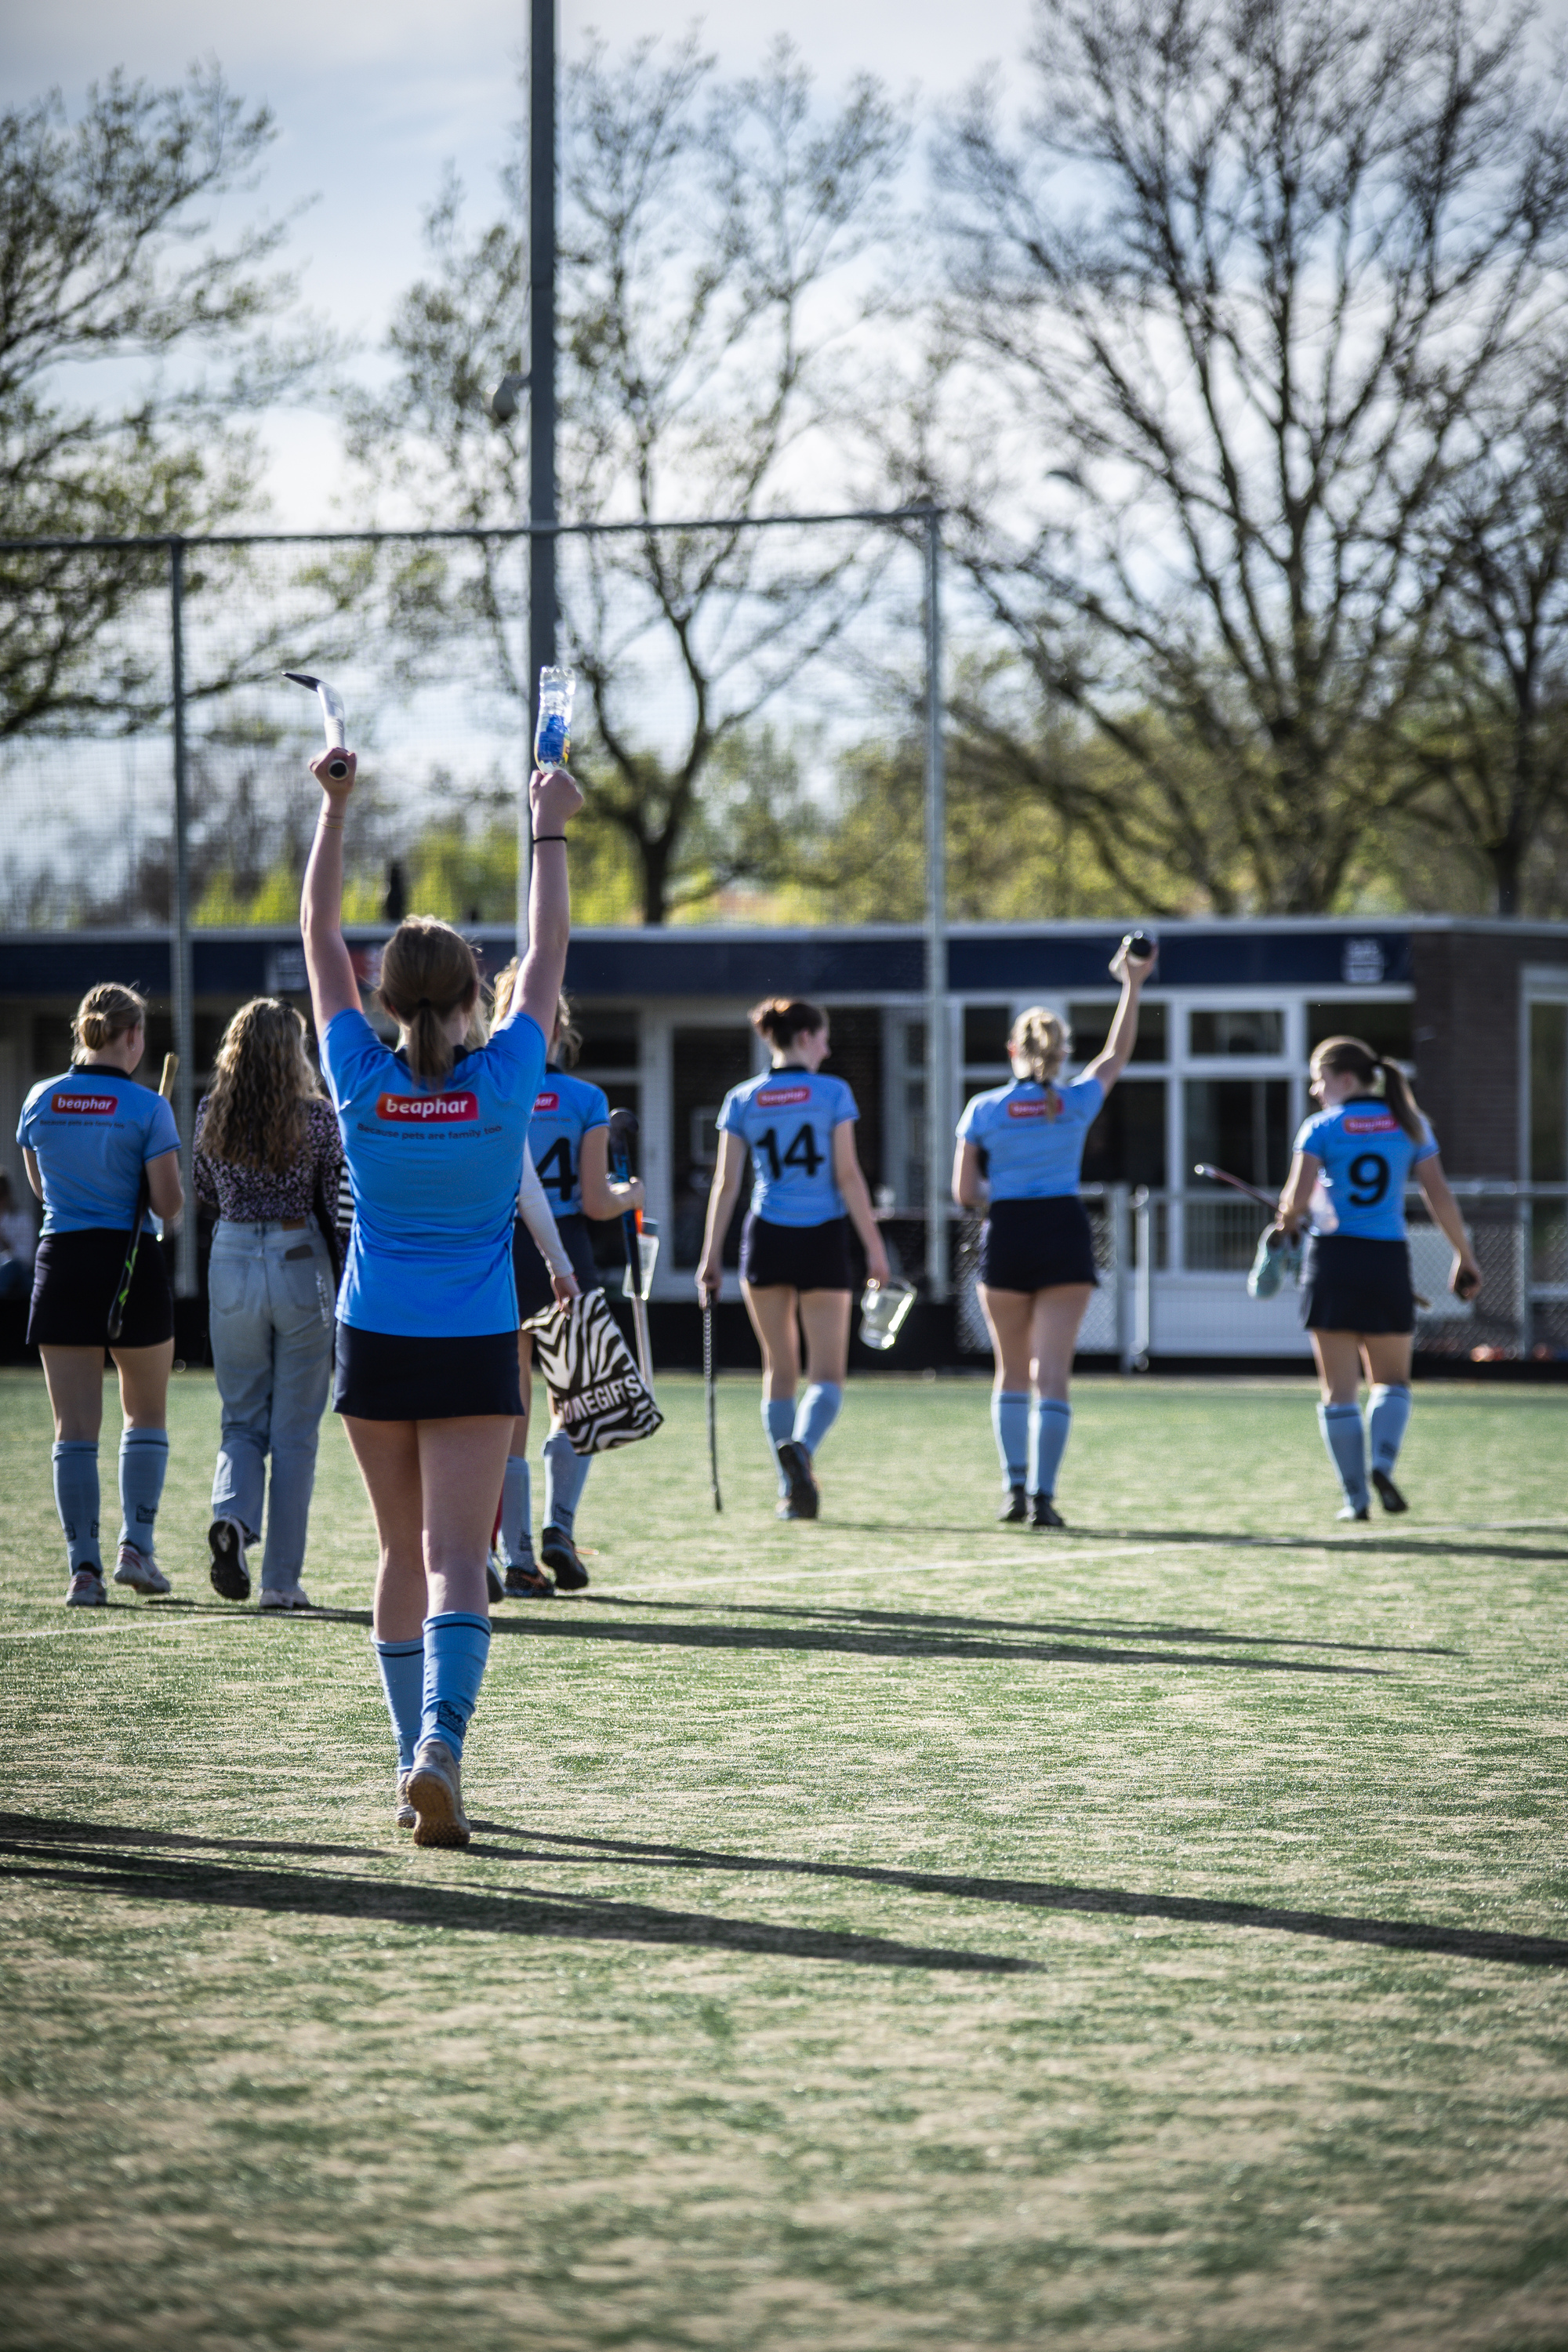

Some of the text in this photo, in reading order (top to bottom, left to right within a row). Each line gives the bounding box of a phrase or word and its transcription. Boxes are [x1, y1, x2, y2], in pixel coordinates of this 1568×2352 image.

[57, 1096, 112, 1112] beaphar
[386, 1098, 468, 1118] beaphar
[357, 1123, 399, 1138] Because
[401, 1131, 425, 1141] pets
[448, 1129, 481, 1140] family
[484, 1125, 502, 1135] too
[756, 1123, 823, 1180] 14
[535, 1137, 578, 1200] 4
[1349, 1153, 1389, 1206] 9
[559, 1374, 643, 1425] OMEGIFTS
